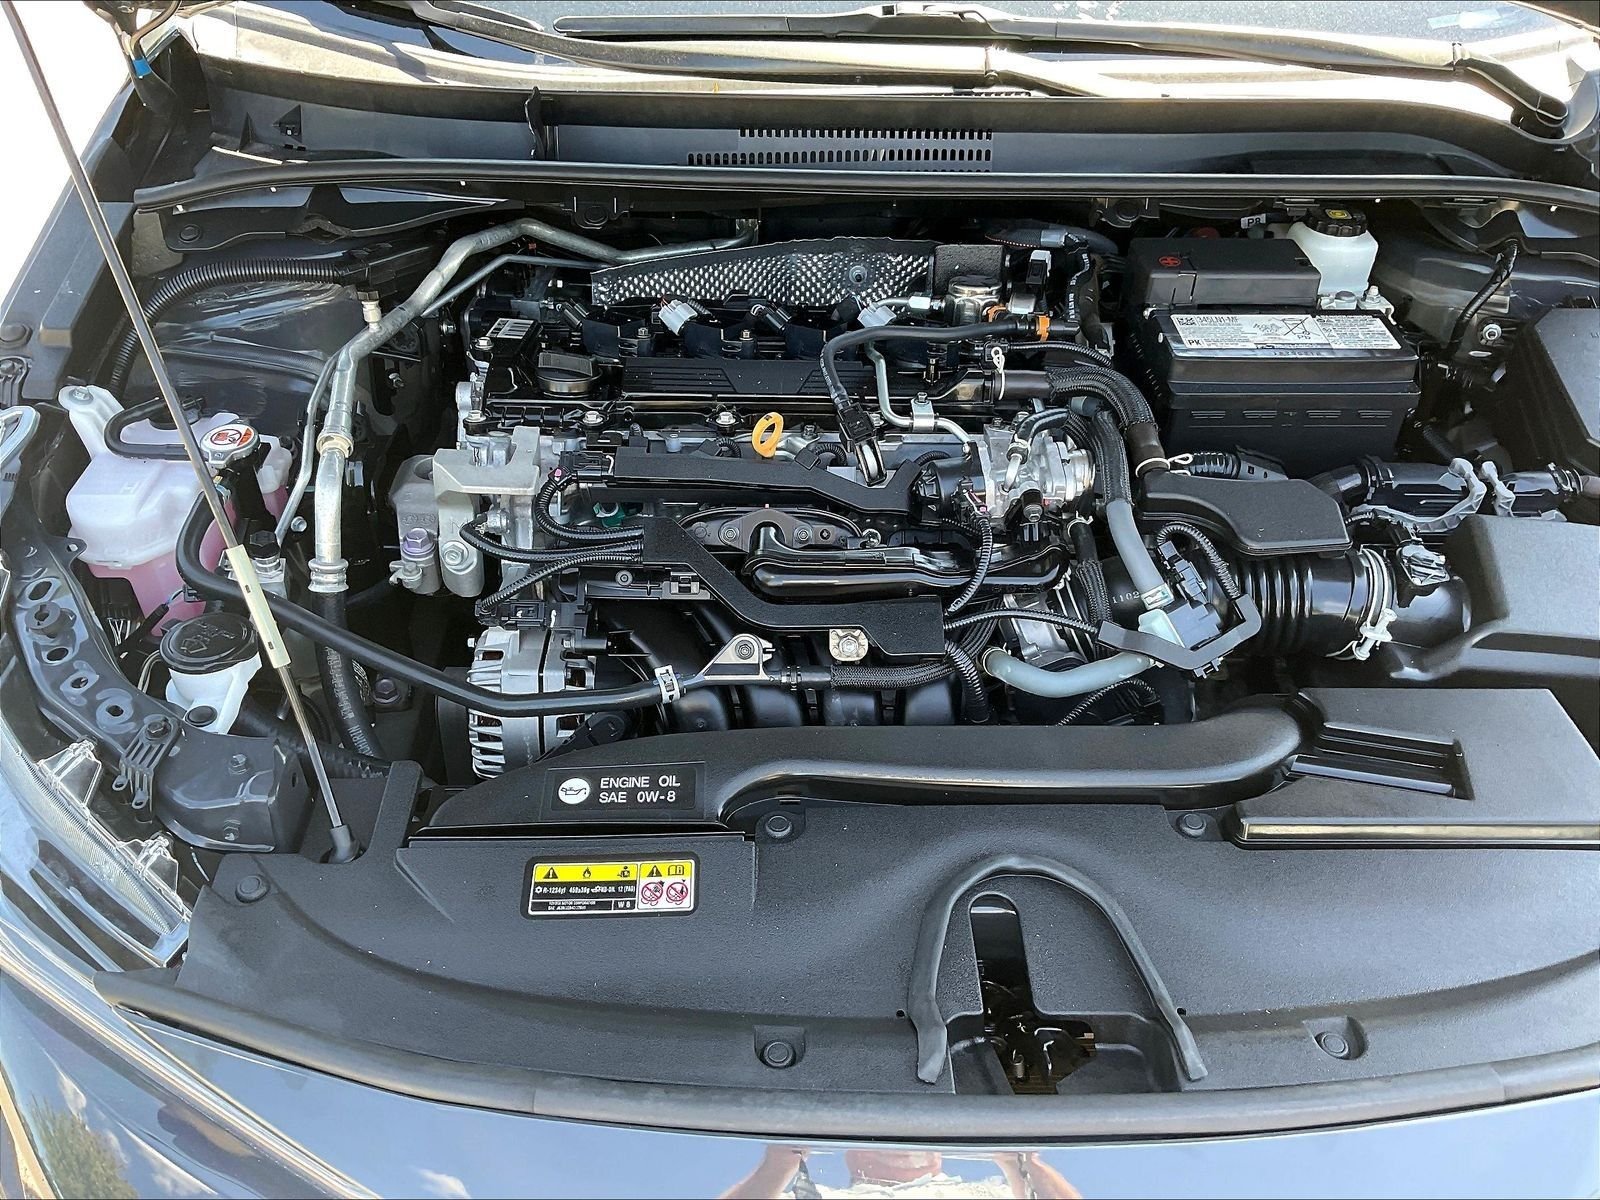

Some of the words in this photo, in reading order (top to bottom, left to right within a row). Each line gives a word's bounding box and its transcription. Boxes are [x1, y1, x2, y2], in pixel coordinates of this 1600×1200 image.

[600, 776, 650, 789] ENGINE
[658, 775, 681, 787] OIL
[599, 791, 627, 803] SAE
[637, 790, 676, 803] 0W-8
